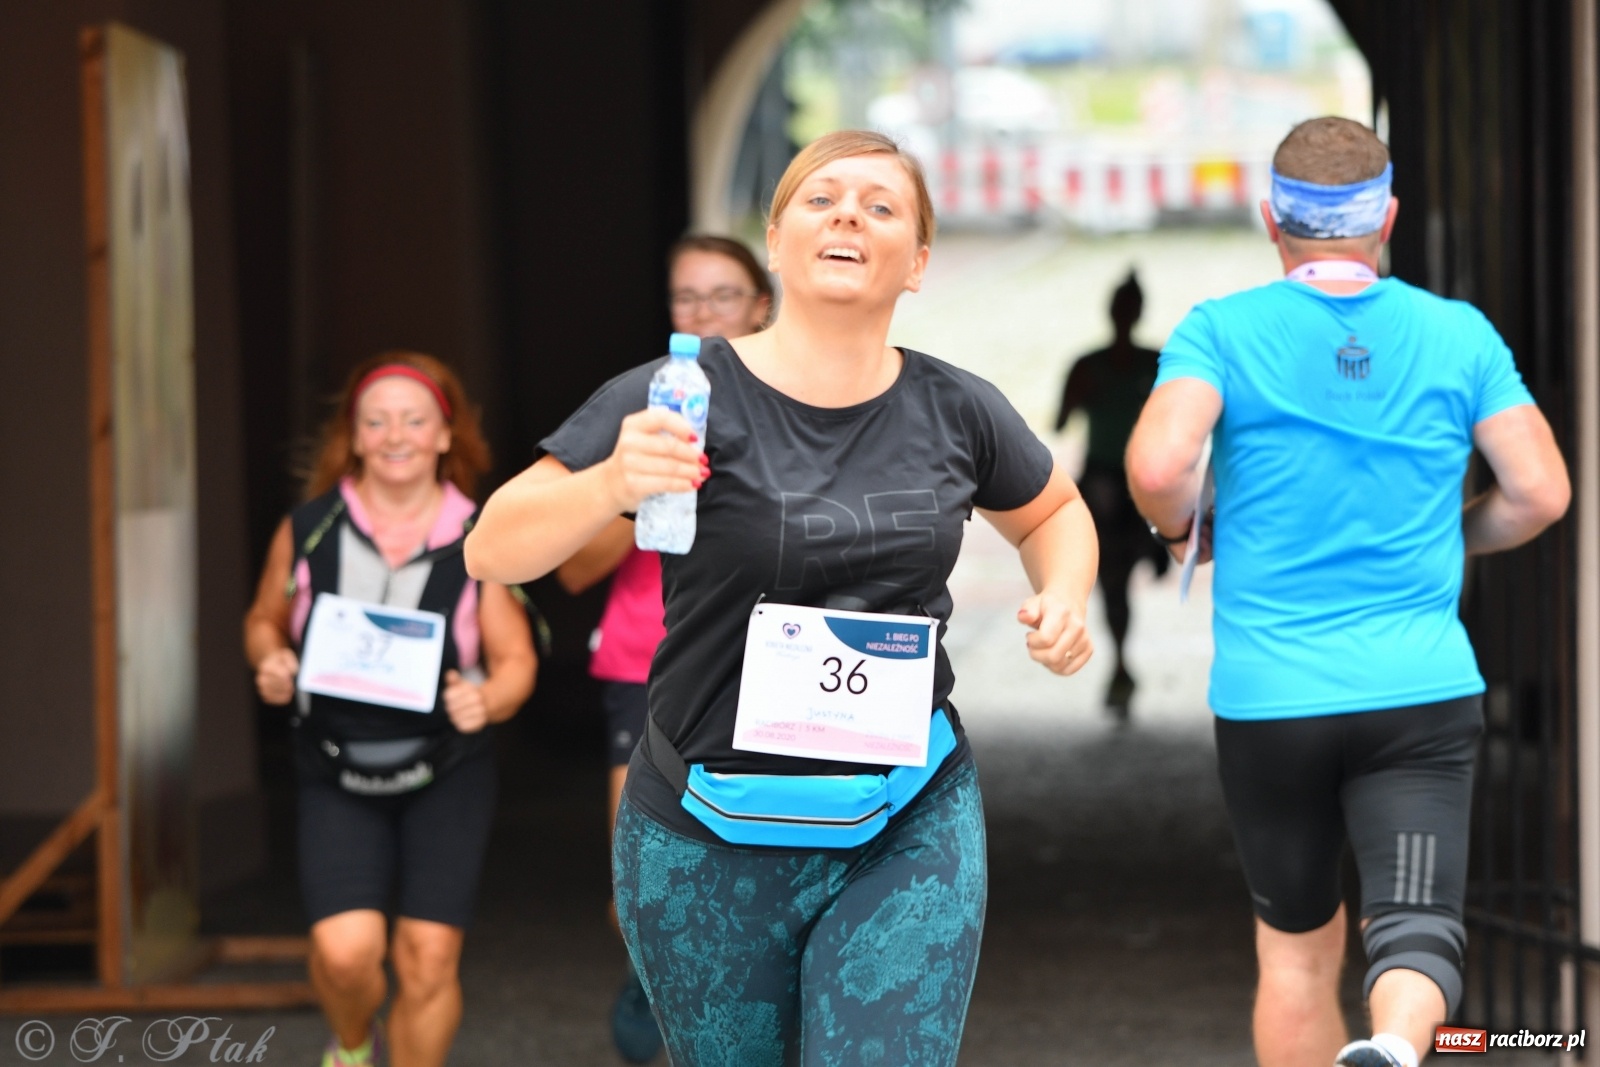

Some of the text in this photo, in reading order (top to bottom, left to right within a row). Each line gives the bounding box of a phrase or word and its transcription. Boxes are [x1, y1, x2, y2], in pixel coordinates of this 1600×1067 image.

[893, 633, 909, 642] BIEG
[909, 634, 919, 643] PO
[819, 656, 869, 695] 36
